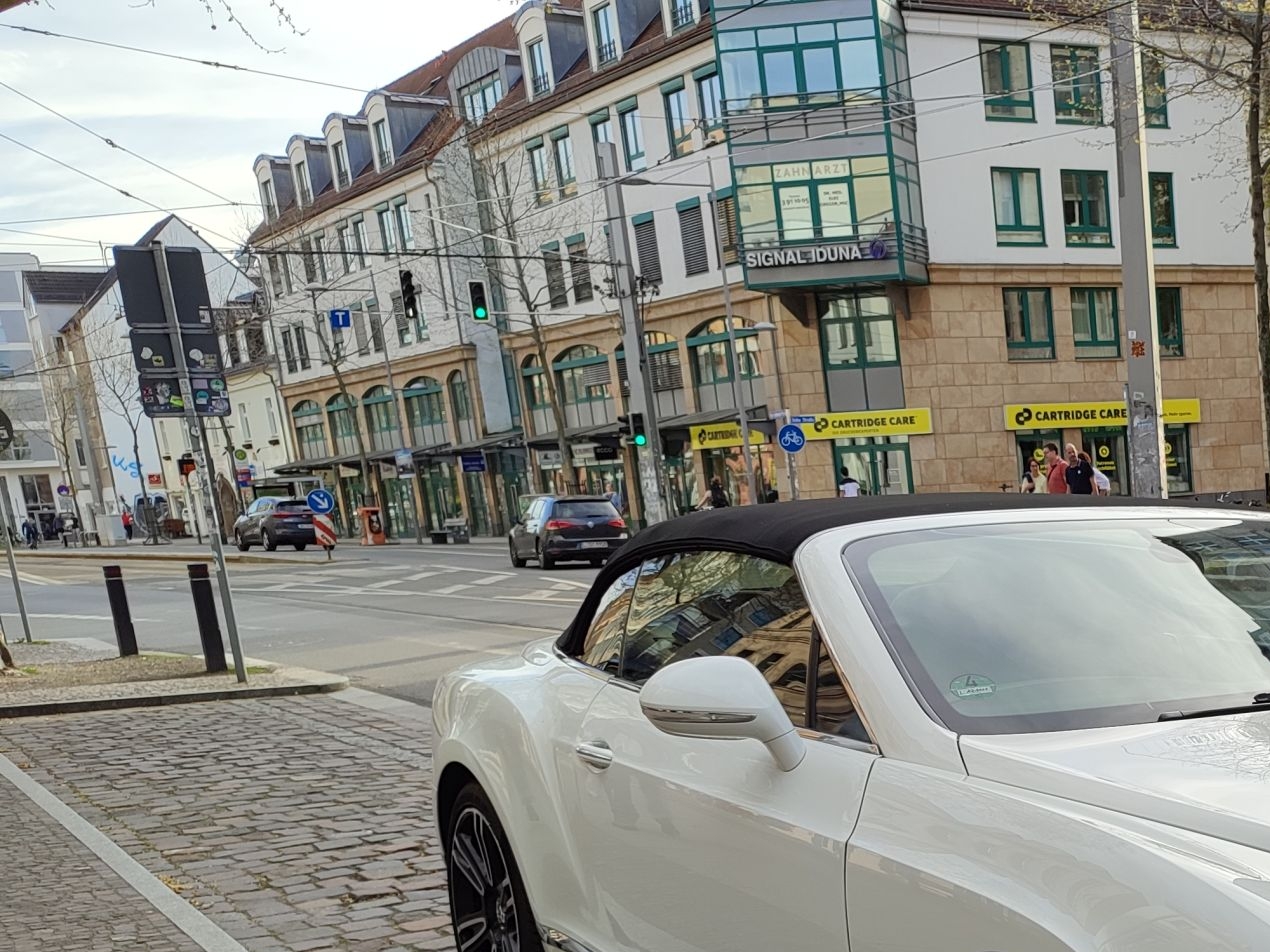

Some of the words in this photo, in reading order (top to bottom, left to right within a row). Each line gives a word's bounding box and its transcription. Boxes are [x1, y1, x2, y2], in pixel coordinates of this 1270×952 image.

[746, 250, 807, 268] SIGNAL
[811, 245, 863, 263] IDUNA
[1035, 409, 1097, 421] CARTRIDGE
[1100, 408, 1128, 419] CARE
[832, 417, 887, 429] CARTRIDGE
[889, 415, 916, 426] CARE
